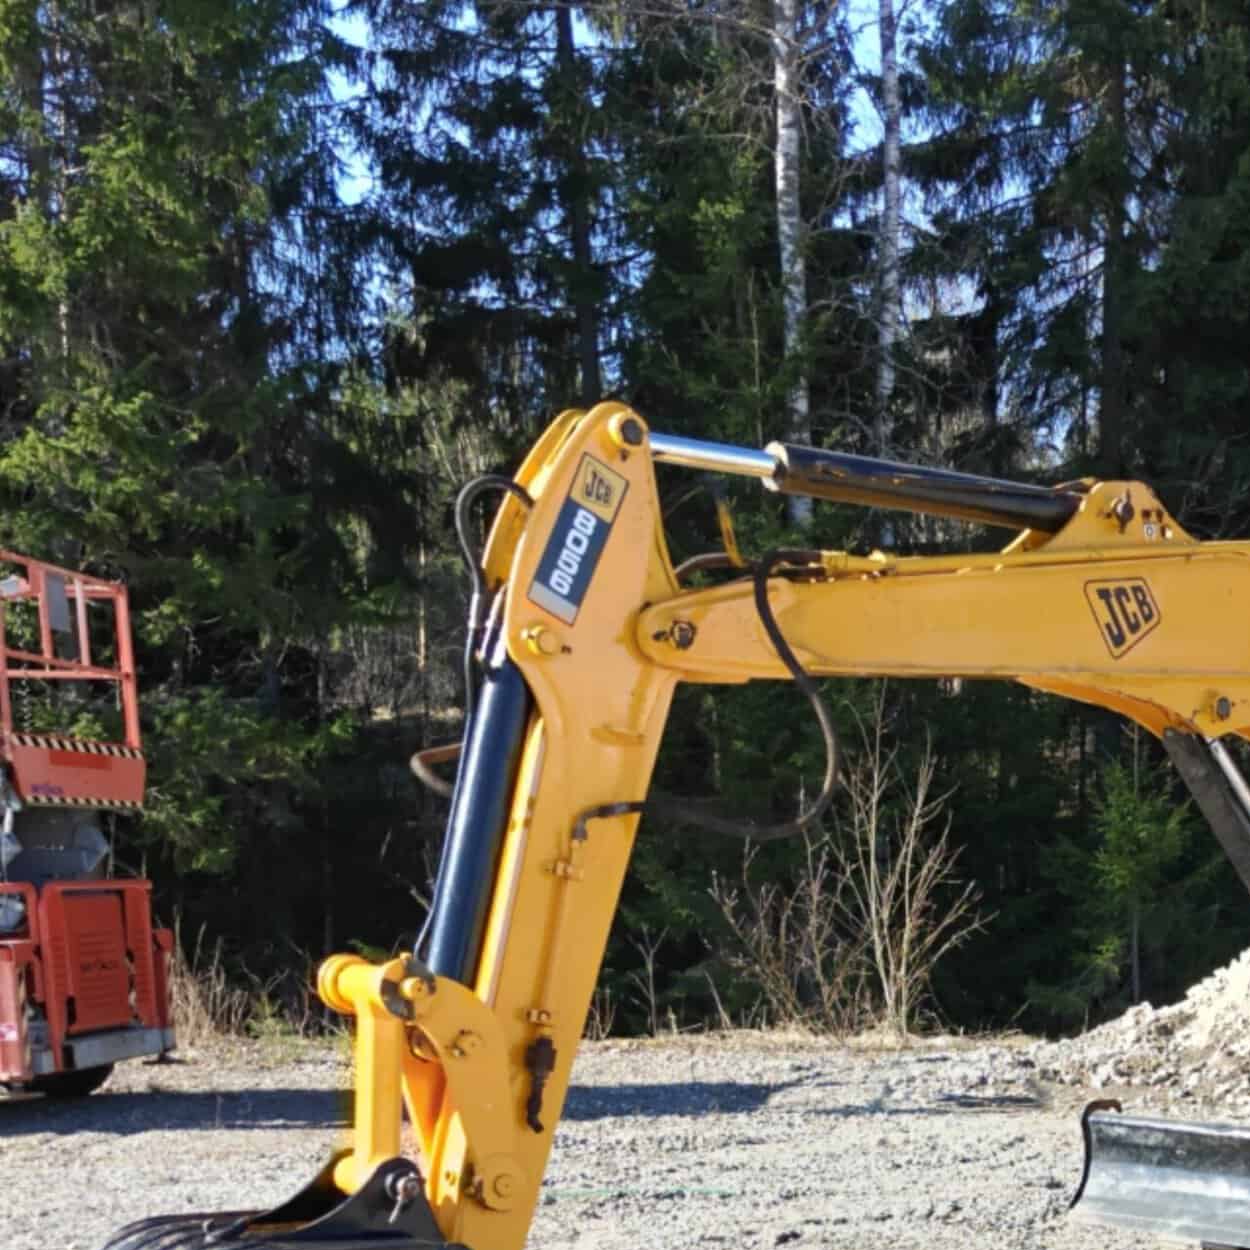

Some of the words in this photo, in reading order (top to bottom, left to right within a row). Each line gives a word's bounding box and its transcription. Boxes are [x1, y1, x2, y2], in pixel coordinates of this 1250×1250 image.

[584, 469, 614, 505] JCB
[549, 507, 598, 596] 8056
[1095, 584, 1154, 649] JCB
